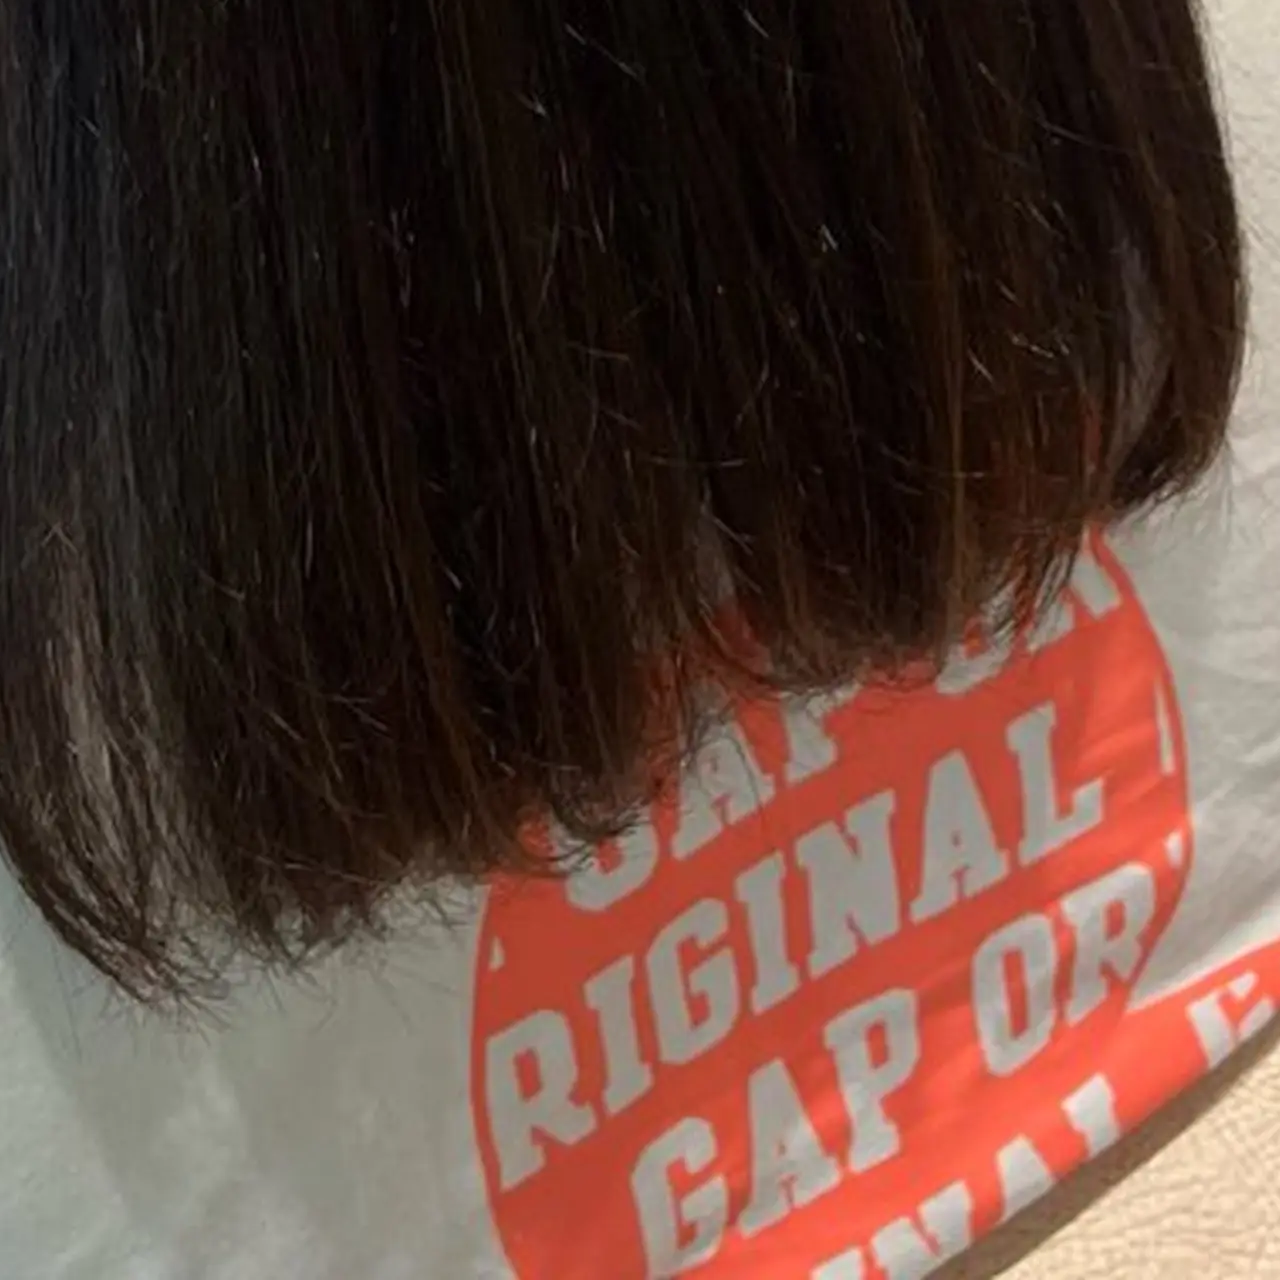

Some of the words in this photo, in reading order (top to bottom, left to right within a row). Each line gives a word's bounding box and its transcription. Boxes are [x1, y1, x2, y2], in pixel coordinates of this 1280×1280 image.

[485, 701, 1103, 1192] RIGINAL
[631, 988, 921, 1279] GAP
[969, 831, 1183, 1076] OR
